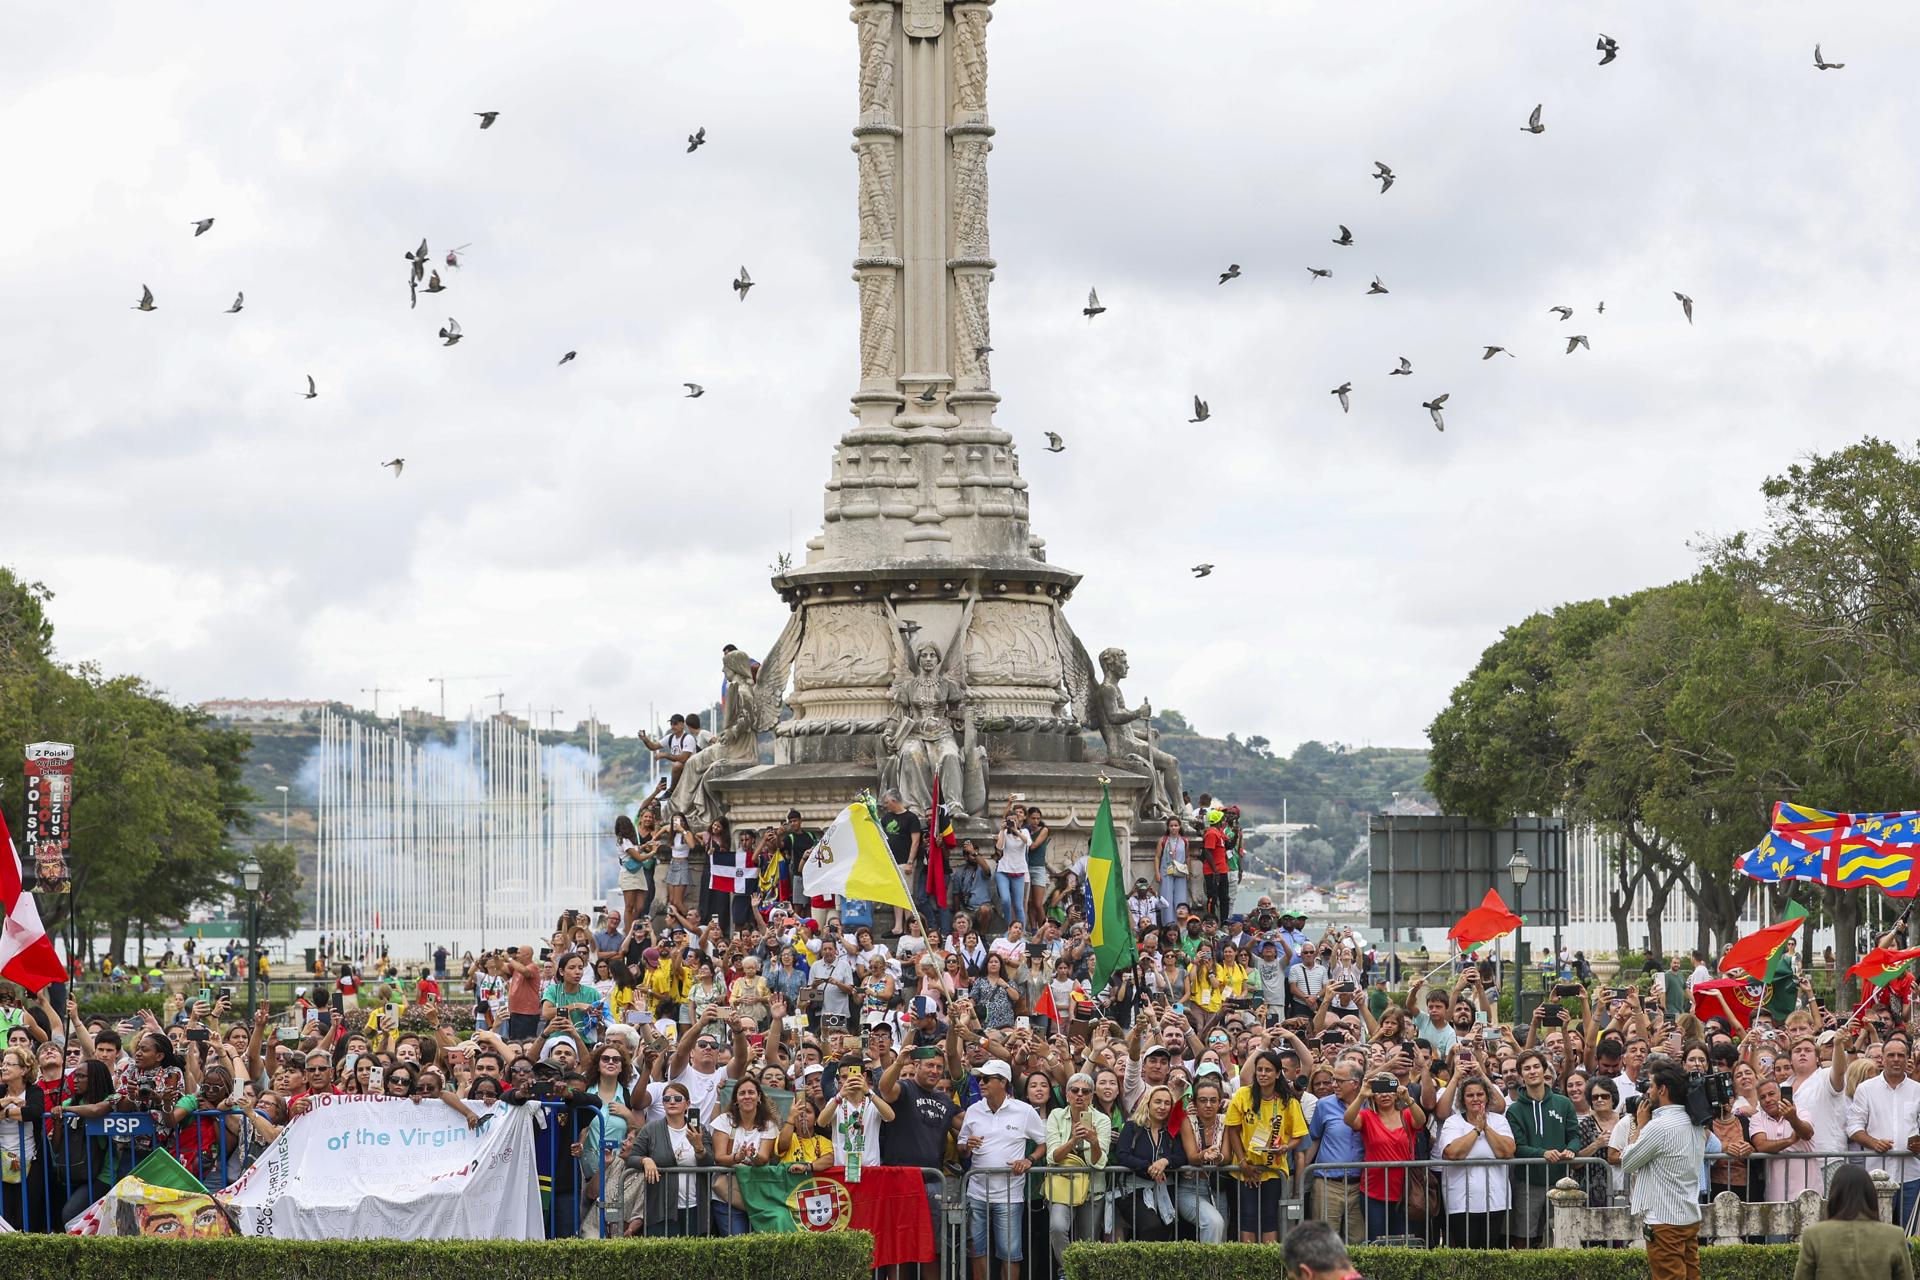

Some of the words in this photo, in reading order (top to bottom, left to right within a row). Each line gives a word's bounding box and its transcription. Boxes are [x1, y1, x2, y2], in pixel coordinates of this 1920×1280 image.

[26, 776, 40, 856] POLSKI
[103, 1118, 140, 1133] PSP
[327, 1131, 351, 1151] of
[355, 1128, 392, 1147] the
[398, 1125, 467, 1148] Virgin
[267, 1159, 280, 1196] CHRIST
